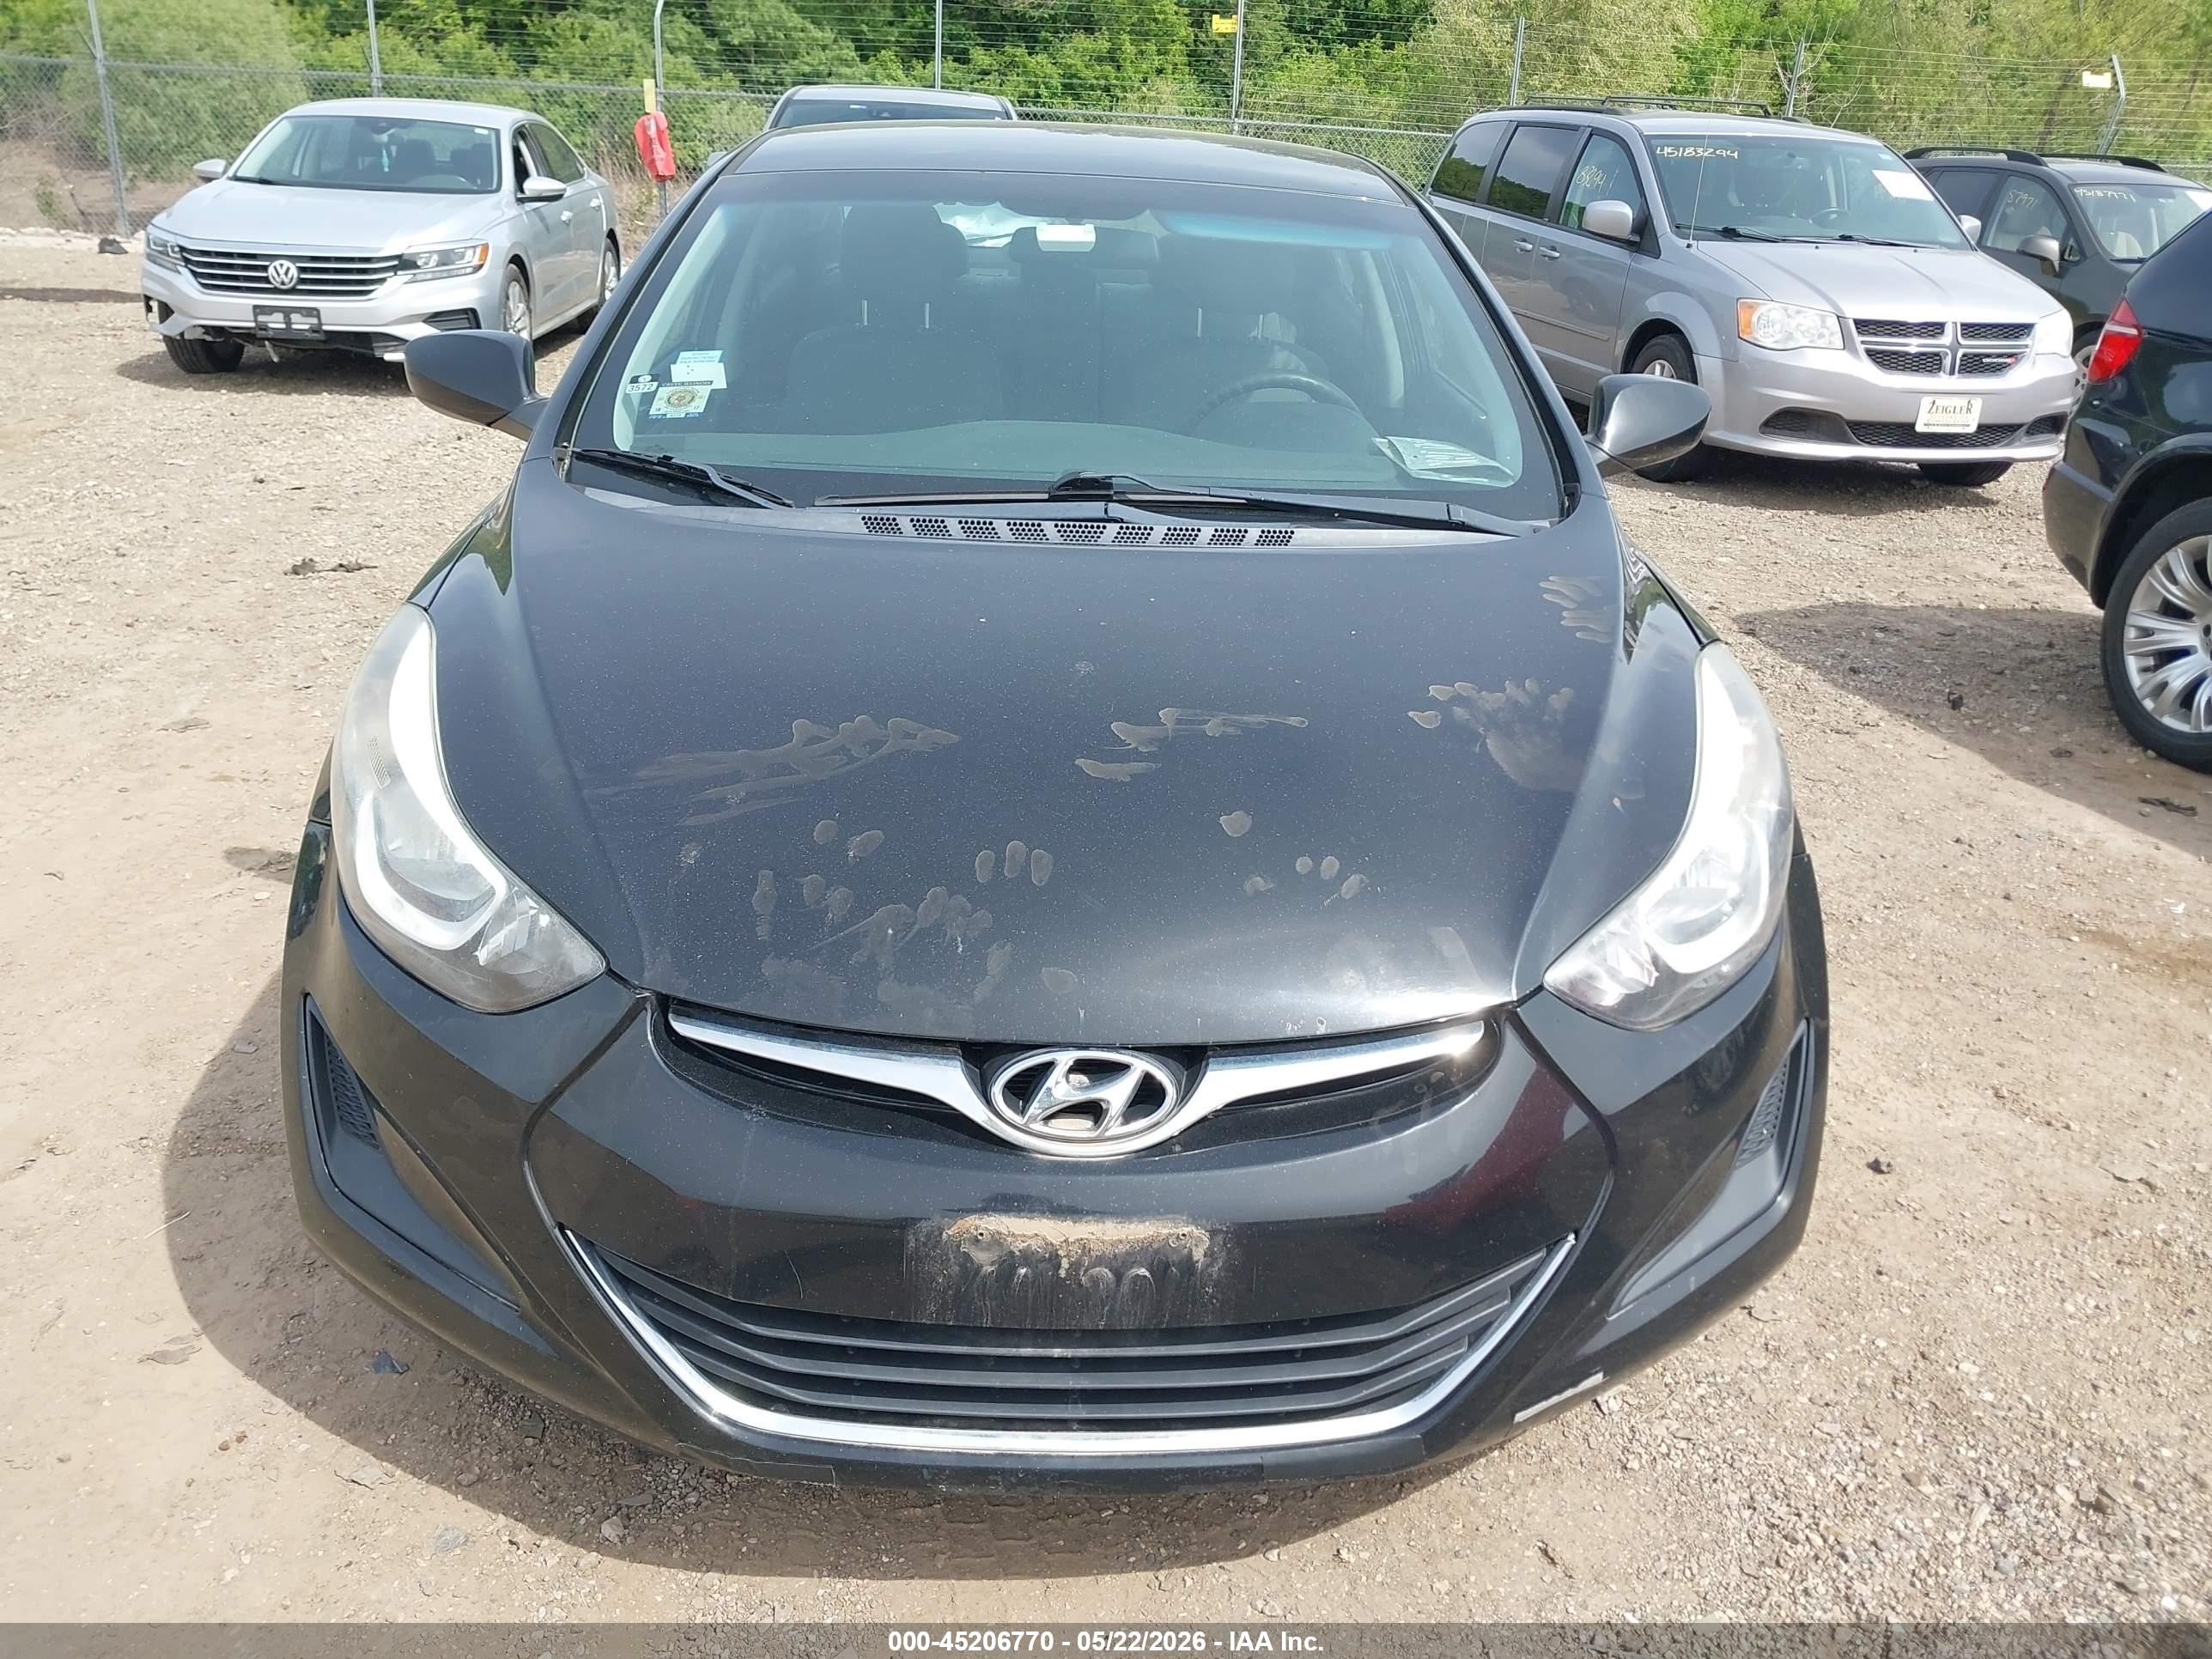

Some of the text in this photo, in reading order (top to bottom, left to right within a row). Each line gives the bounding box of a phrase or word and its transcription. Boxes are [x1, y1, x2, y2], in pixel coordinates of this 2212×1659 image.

[1656, 145, 1739, 160] 45183294
[628, 383, 654, 392] 3572
[1928, 399, 1972, 414] ZEIGLER
